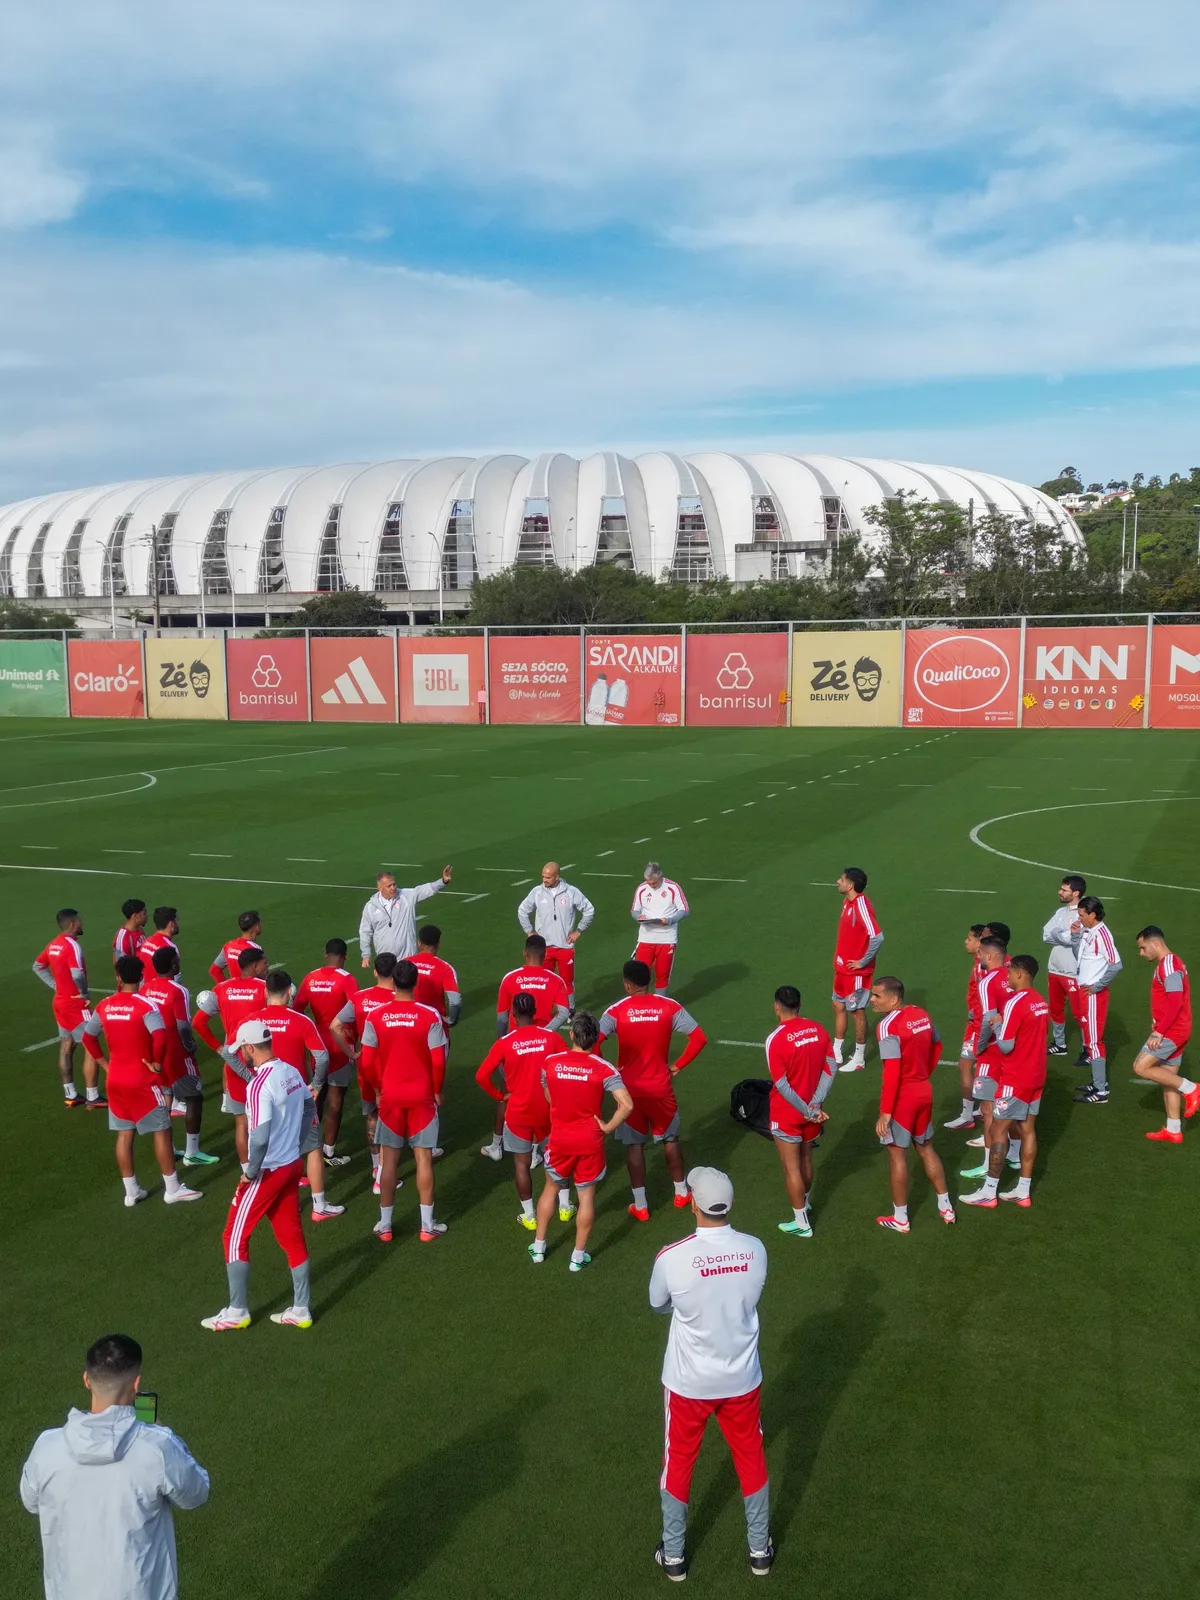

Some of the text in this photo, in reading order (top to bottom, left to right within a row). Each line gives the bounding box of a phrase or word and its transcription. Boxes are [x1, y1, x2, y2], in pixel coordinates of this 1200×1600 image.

[589, 643, 679, 673] SARANDI
[501, 660, 569, 673] SEJA SÓCIO,
[633, 665, 678, 674] ALKALINE
[0, 669, 43, 681] Unimed
[159, 662, 188, 689] Zé
[424, 668, 459, 691] JBL
[503, 672, 567, 684] SEJA SÓCIA
[810, 660, 850, 691] Zé
[922, 664, 1001, 686] QualiCoco
[74, 671, 129, 692] Claro
[1043, 685, 1118, 694] IDIOMAS
[240, 691, 298, 705] banrisul
[699, 693, 772, 709] banrisul
[810, 693, 850, 702] DELIVERY
[389, 1012, 418, 1020] banrisul
[520, 1038, 547, 1047] banrisul
[794, 1035, 819, 1047] Unimed
[517, 1045, 545, 1055] Unimed
[563, 1065, 593, 1074] banrisul
[557, 1073, 588, 1081] Unimed
[706, 1251, 754, 1264] banrisul
[700, 1263, 749, 1278] Unimed
